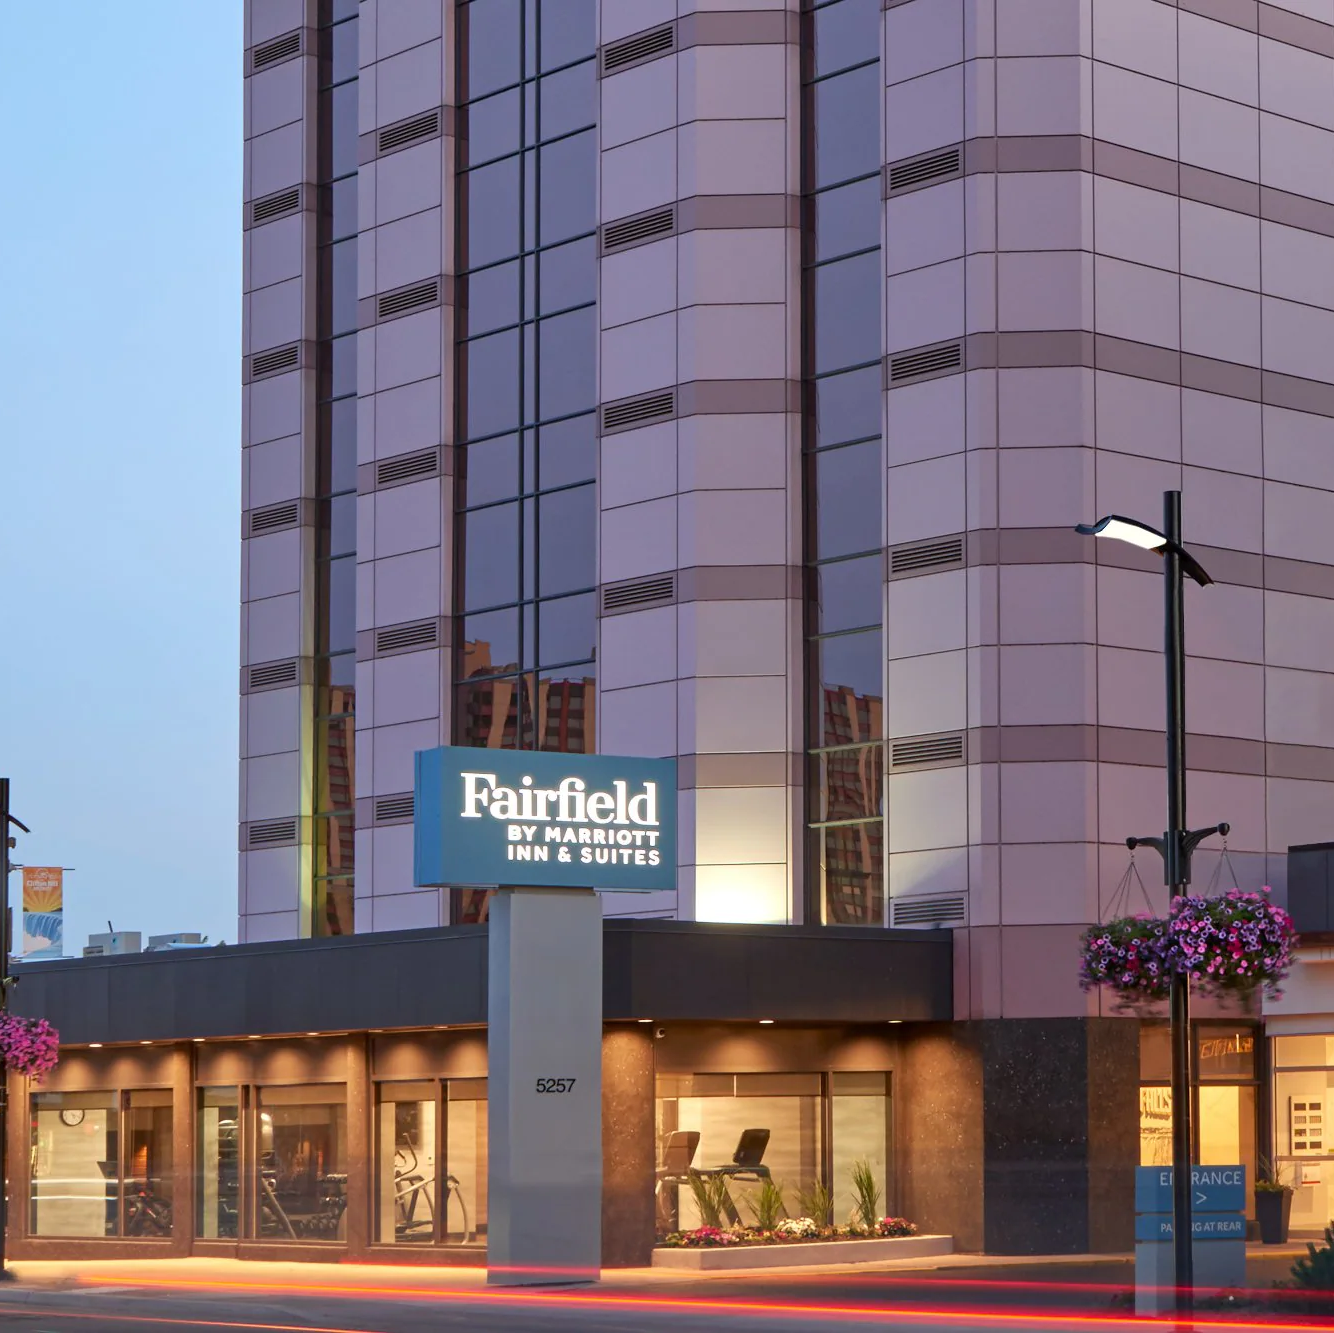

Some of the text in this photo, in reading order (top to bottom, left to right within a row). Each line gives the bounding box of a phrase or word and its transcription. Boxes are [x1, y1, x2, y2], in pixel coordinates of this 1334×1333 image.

[460, 772, 660, 826] Fairfield
[507, 825, 660, 847] BY MARRIOTT
[507, 845, 661, 866] INN & SUITES
[536, 1078, 576, 1093] 5257
[1160, 1171, 1241, 1186] ERANCE
[1203, 1222, 1215, 1232] AT
[1217, 1221, 1242, 1231] REAR
